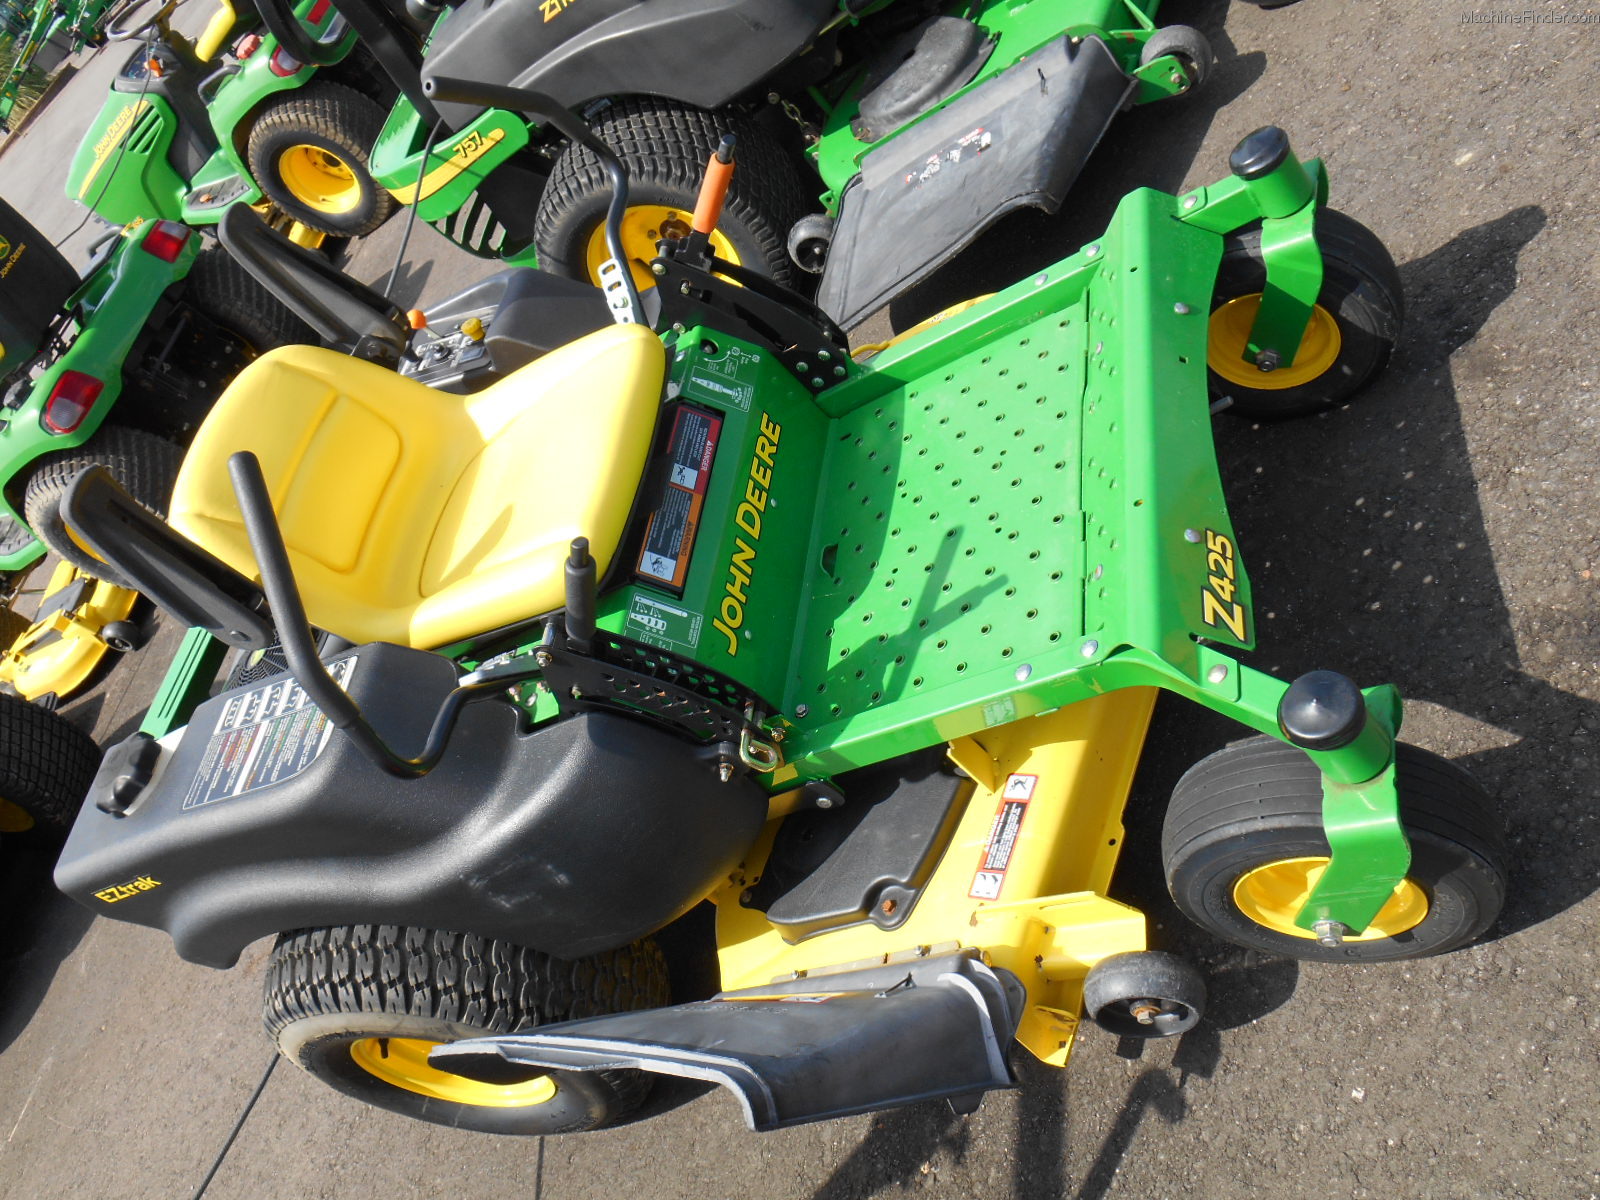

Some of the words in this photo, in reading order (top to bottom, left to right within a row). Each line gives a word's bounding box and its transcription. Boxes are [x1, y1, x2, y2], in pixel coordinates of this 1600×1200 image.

[93, 133, 112, 160] JOHN
[107, 104, 132, 139] DEERE
[453, 130, 483, 158] 757
[699, 444, 714, 472] DANGER
[734, 412, 781, 541] DEERE
[712, 538, 757, 657] JOHN
[1202, 528, 1246, 642] Z425
[94, 876, 162, 903] EZtrak
